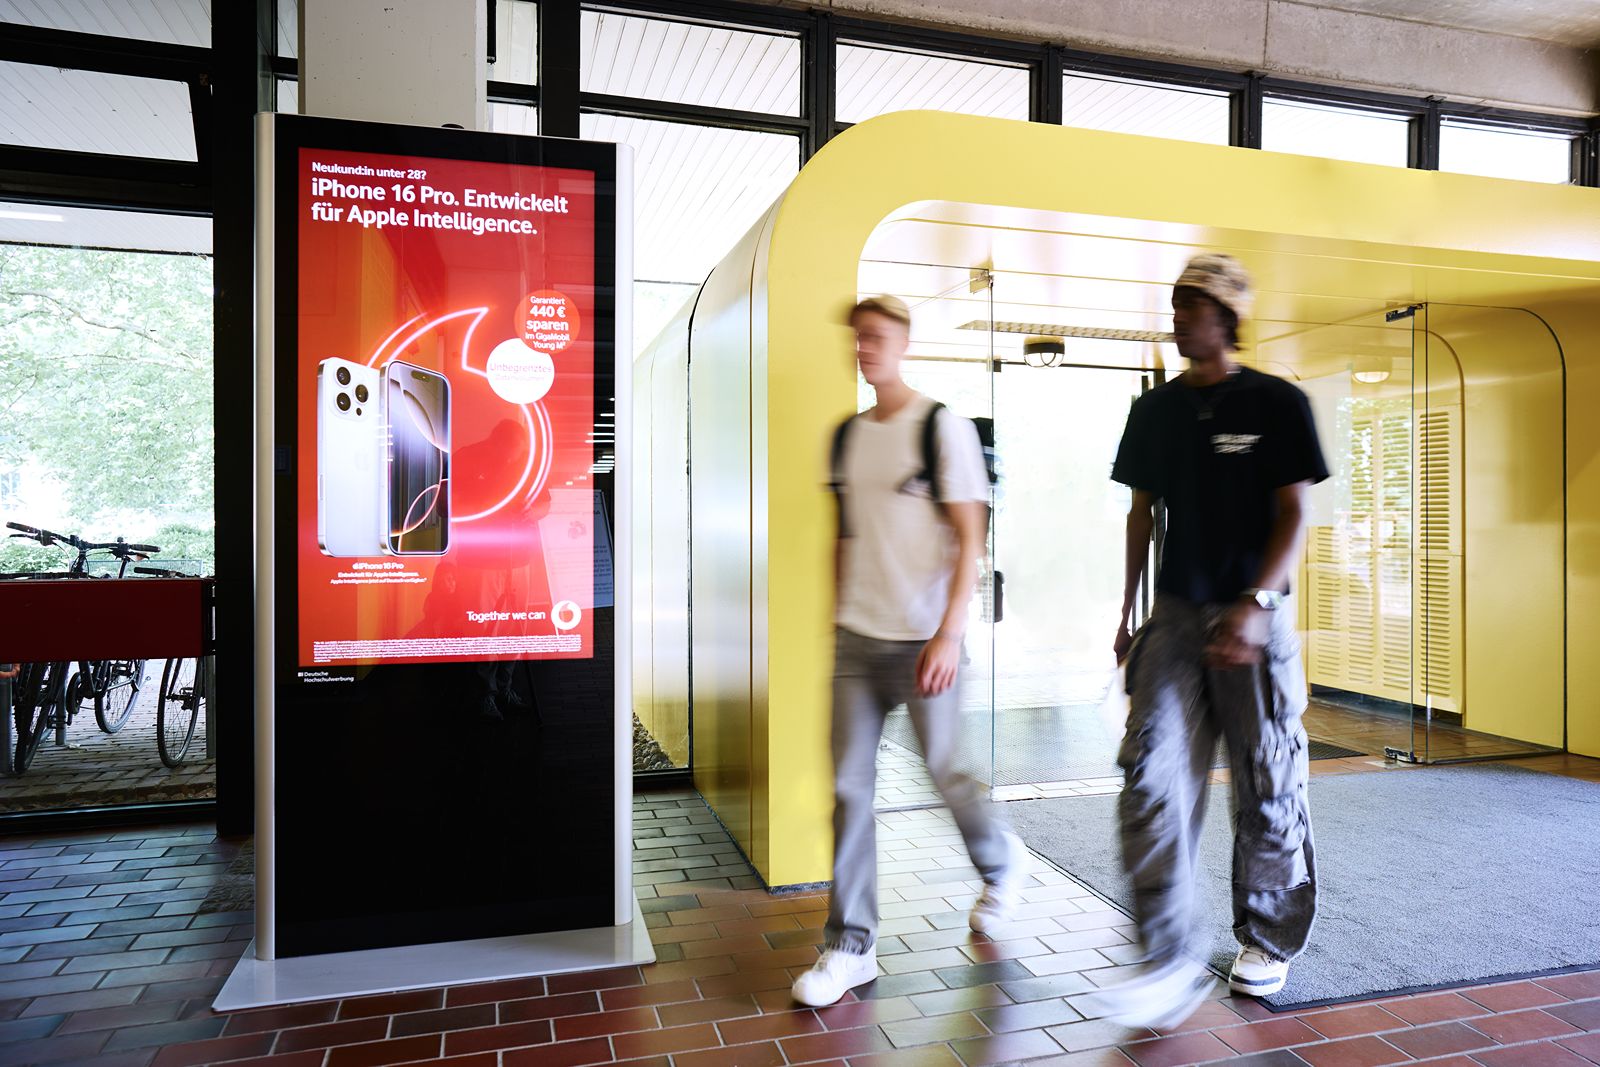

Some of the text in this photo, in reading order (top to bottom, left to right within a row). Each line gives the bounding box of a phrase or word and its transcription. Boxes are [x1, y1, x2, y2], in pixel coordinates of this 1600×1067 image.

[312, 161, 427, 180] Neukund:in unter 28?
[312, 177, 569, 214] iPhone 16 Pro. Entwickelt
[311, 202, 538, 235] für Apple Intelligence.
[530, 296, 566, 305] Garantiert
[530, 305, 566, 318] 440 €
[526, 320, 569, 332] sparen
[535, 333, 570, 341] GigaMobil
[533, 341, 555, 350] Young
[489, 363, 552, 374] Unbegrenztes
[358, 562, 383, 570] iPhone
[466, 611, 546, 623] Together we can
